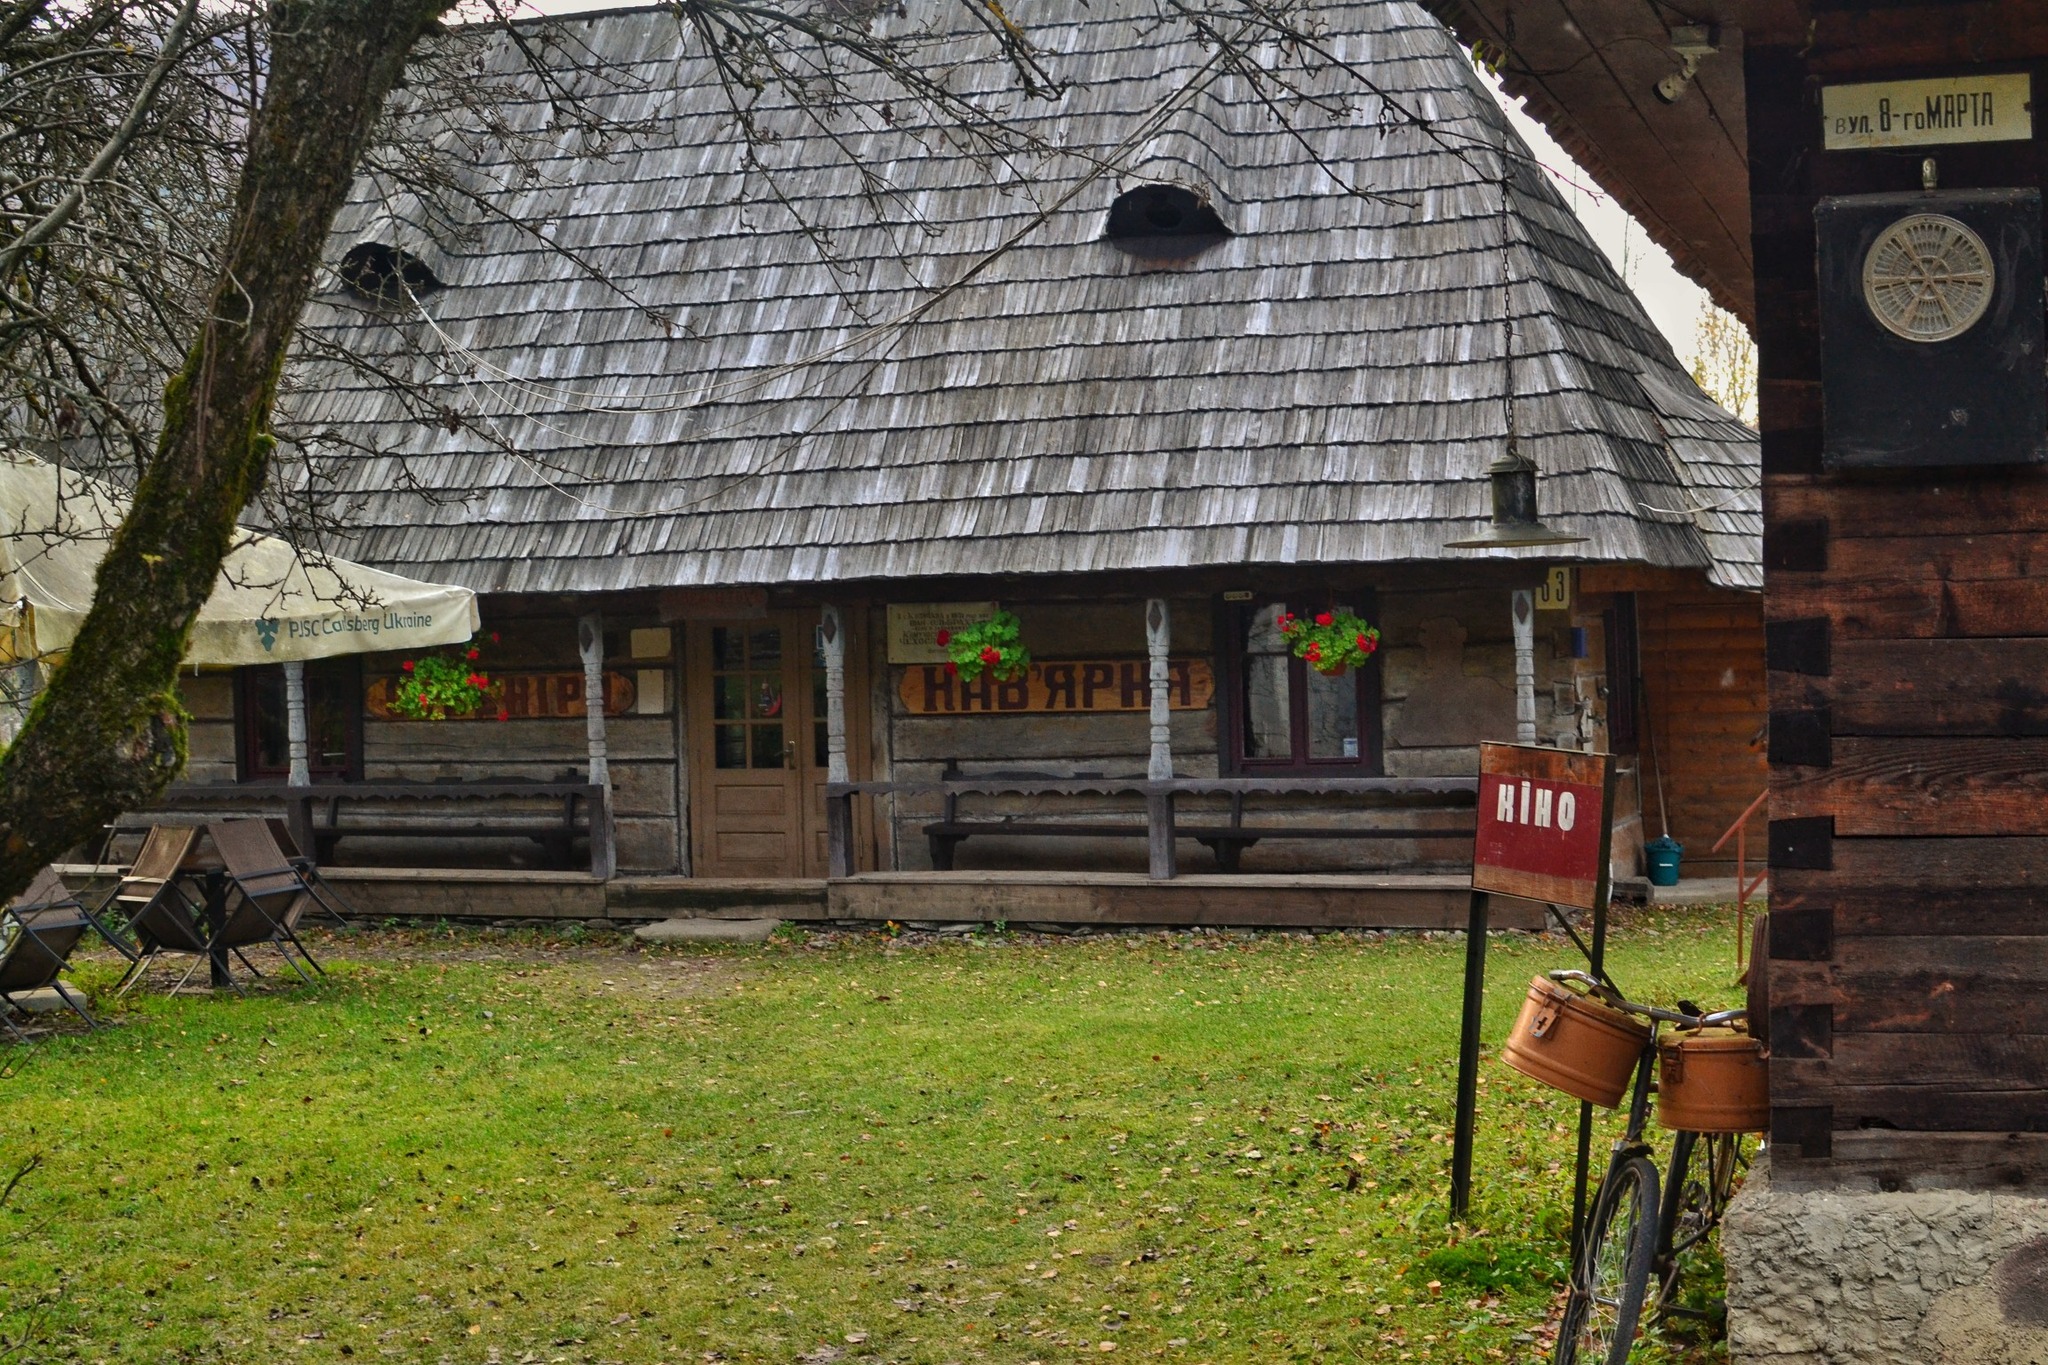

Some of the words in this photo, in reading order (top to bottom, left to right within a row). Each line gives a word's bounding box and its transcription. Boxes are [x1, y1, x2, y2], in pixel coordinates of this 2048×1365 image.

[289, 619, 322, 639] PJSC
[383, 611, 432, 630] Ukraine
[1497, 781, 1576, 832] КІНО
